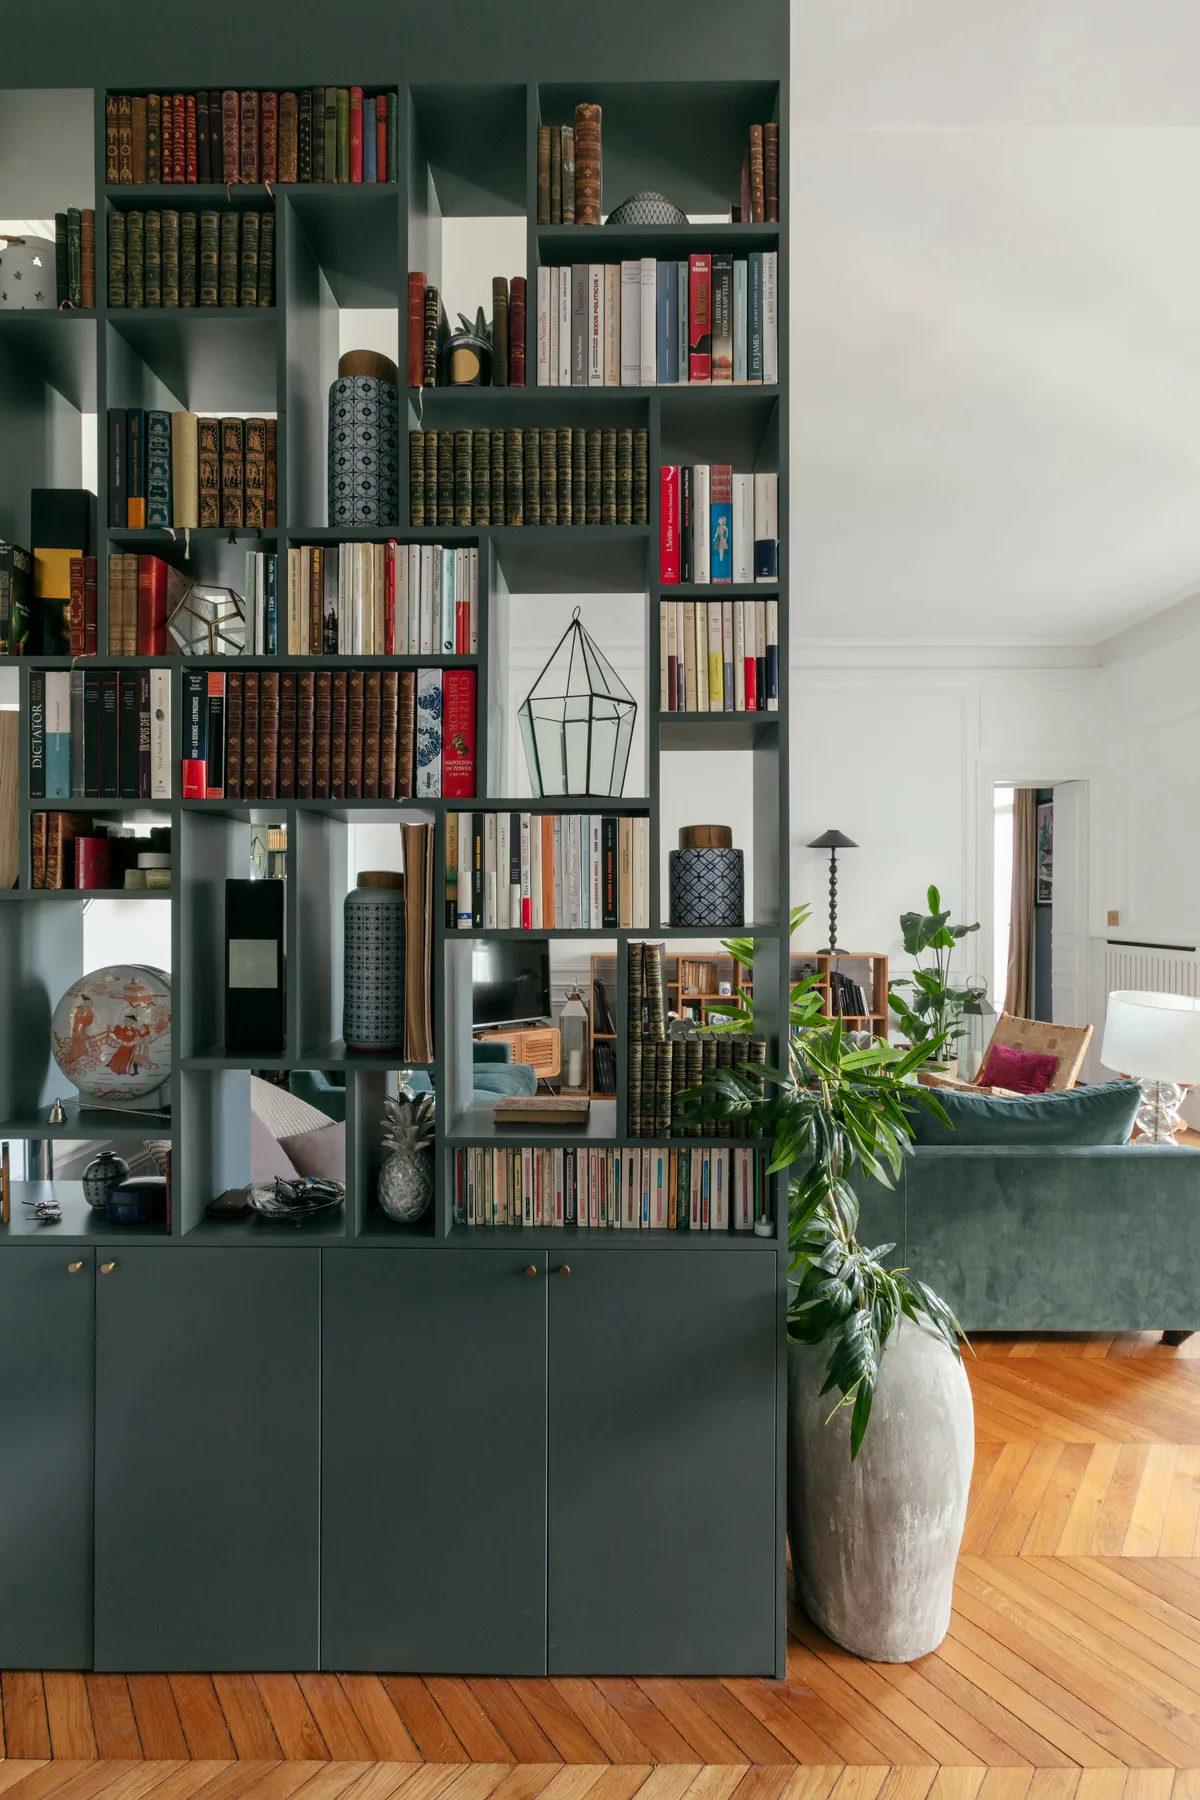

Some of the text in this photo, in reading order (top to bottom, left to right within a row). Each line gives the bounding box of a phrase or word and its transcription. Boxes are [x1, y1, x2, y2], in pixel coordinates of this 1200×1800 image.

[575, 282, 584, 316] Passions
[449, 677, 458, 732] EMPEROR
[459, 677, 469, 730] CITIZEN
[32, 704, 42, 768] DICTATOR
[141, 727, 150, 746] L'OPUS
